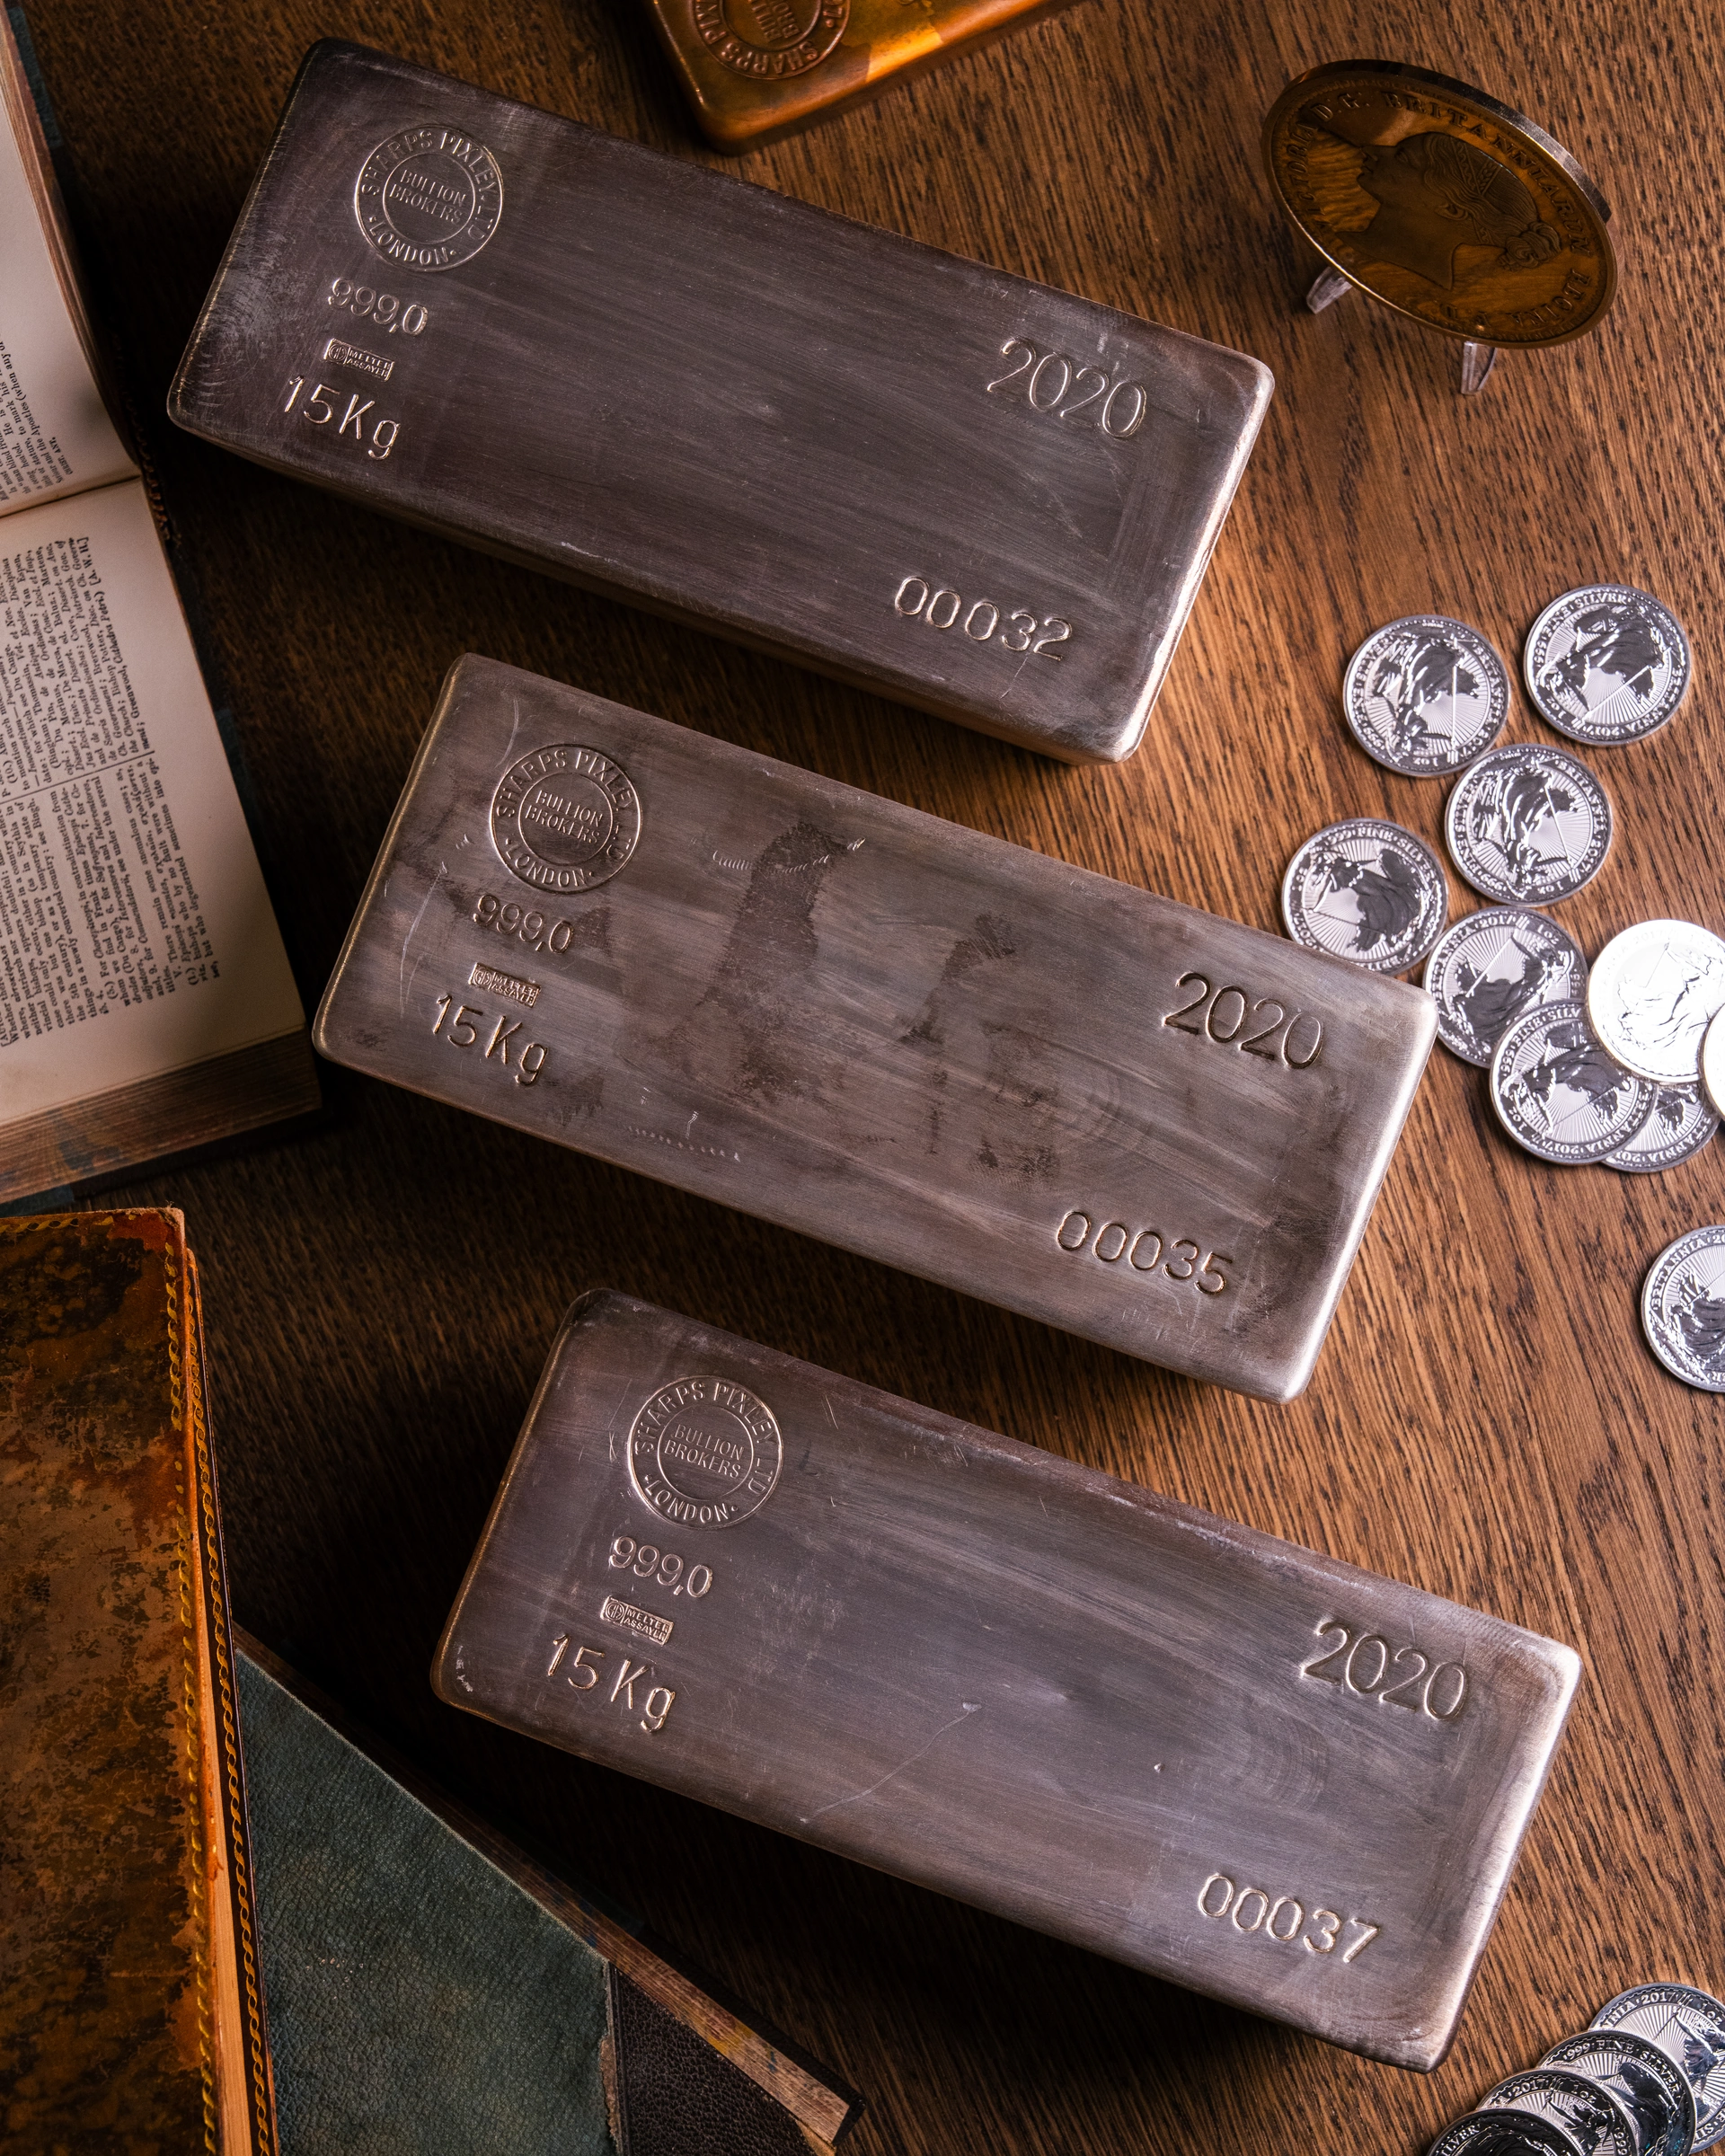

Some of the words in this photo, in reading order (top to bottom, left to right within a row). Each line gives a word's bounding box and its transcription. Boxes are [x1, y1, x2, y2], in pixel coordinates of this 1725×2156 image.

[721, 40, 818, 75] SHARPS
[361, 130, 433, 196] SHARPS
[440, 132, 498, 194] PIXLEY
[389, 184, 463, 225] BROKERS
[400, 169, 466, 208] BULLION
[369, 220, 449, 265] LONDON
[327, 277, 429, 336] 999,0
[1, 354, 13, 369] any
[9, 372, 26, 401] (when
[987, 336, 1146, 438] 2020
[22, 402, 40, 436] Apostles
[37, 438, 47, 451] the
[894, 575, 1073, 660] 00032
[1534, 641, 1547, 665] 999
[1576, 593, 1627, 607] SILVER
[80, 623, 102, 675] Brerewood,
[97, 630, 111, 663] Potter,
[22, 664, 42, 715] Thomassin,
[107, 665, 121, 696] Bishop
[118, 665, 140, 719] Greenwood,
[138, 773, 155, 808] without
[497, 749, 567, 817] SHARPS
[576, 751, 633, 811] PIXLEY
[6, 806, 14, 816] in
[27, 798, 42, 829] Bingh.
[152, 813, 163, 835] were
[526, 805, 600, 844] BROKERS
[535, 790, 603, 826] BULLION
[11, 821, 26, 857] Scythia
[39, 831, 47, 845] see
[129, 818, 148, 865] anomalous
[22, 862, 31, 872] in
[145, 870, 156, 893] some
[169, 867, 177, 879] no
[506, 843, 588, 888] LONDON
[33, 897, 47, 928] bishop
[53, 890, 73, 935] converted
[153, 897, 169, 930] remain
[179, 901, 190, 921] who
[473, 894, 575, 954] 999,0
[43, 932, 52, 948] one
[67, 938, 82, 965] newly
[165, 934, 178, 963] There
[49, 953, 59, 970] but
[56, 976, 66, 994] was
[80, 975, 88, 986] in
[63, 1000, 75, 1025] there
[84, 987, 98, 1018] things
[1163, 971, 1324, 1069] 2020
[1499, 1048, 1517, 1073] 999
[1547, 1008, 1581, 1020] SILV
[1057, 1211, 1233, 1295] 00035
[634, 1382, 705, 1455] SHARPS
[713, 1383, 778, 1444] PIXLEY
[664, 1439, 741, 1478] BROKERS
[675, 1424, 745, 1461] BULLION
[645, 1480, 729, 1524] LONDON
[610, 1535, 713, 1598] 999,0
[627, 1609, 670, 1632] MELTER
[1301, 1621, 1470, 1722] 2020
[1199, 1873, 1381, 1963] 00037
[1641, 1992, 1678, 2004] 2017
[1566, 2043, 1591, 2060] 999
[1597, 2039, 1634, 2054] FINE
[1640, 2051, 1680, 2094] SILVER
[1511, 2078, 1546, 2096] 2017
[1438, 2123, 1479, 2156] ILVER
